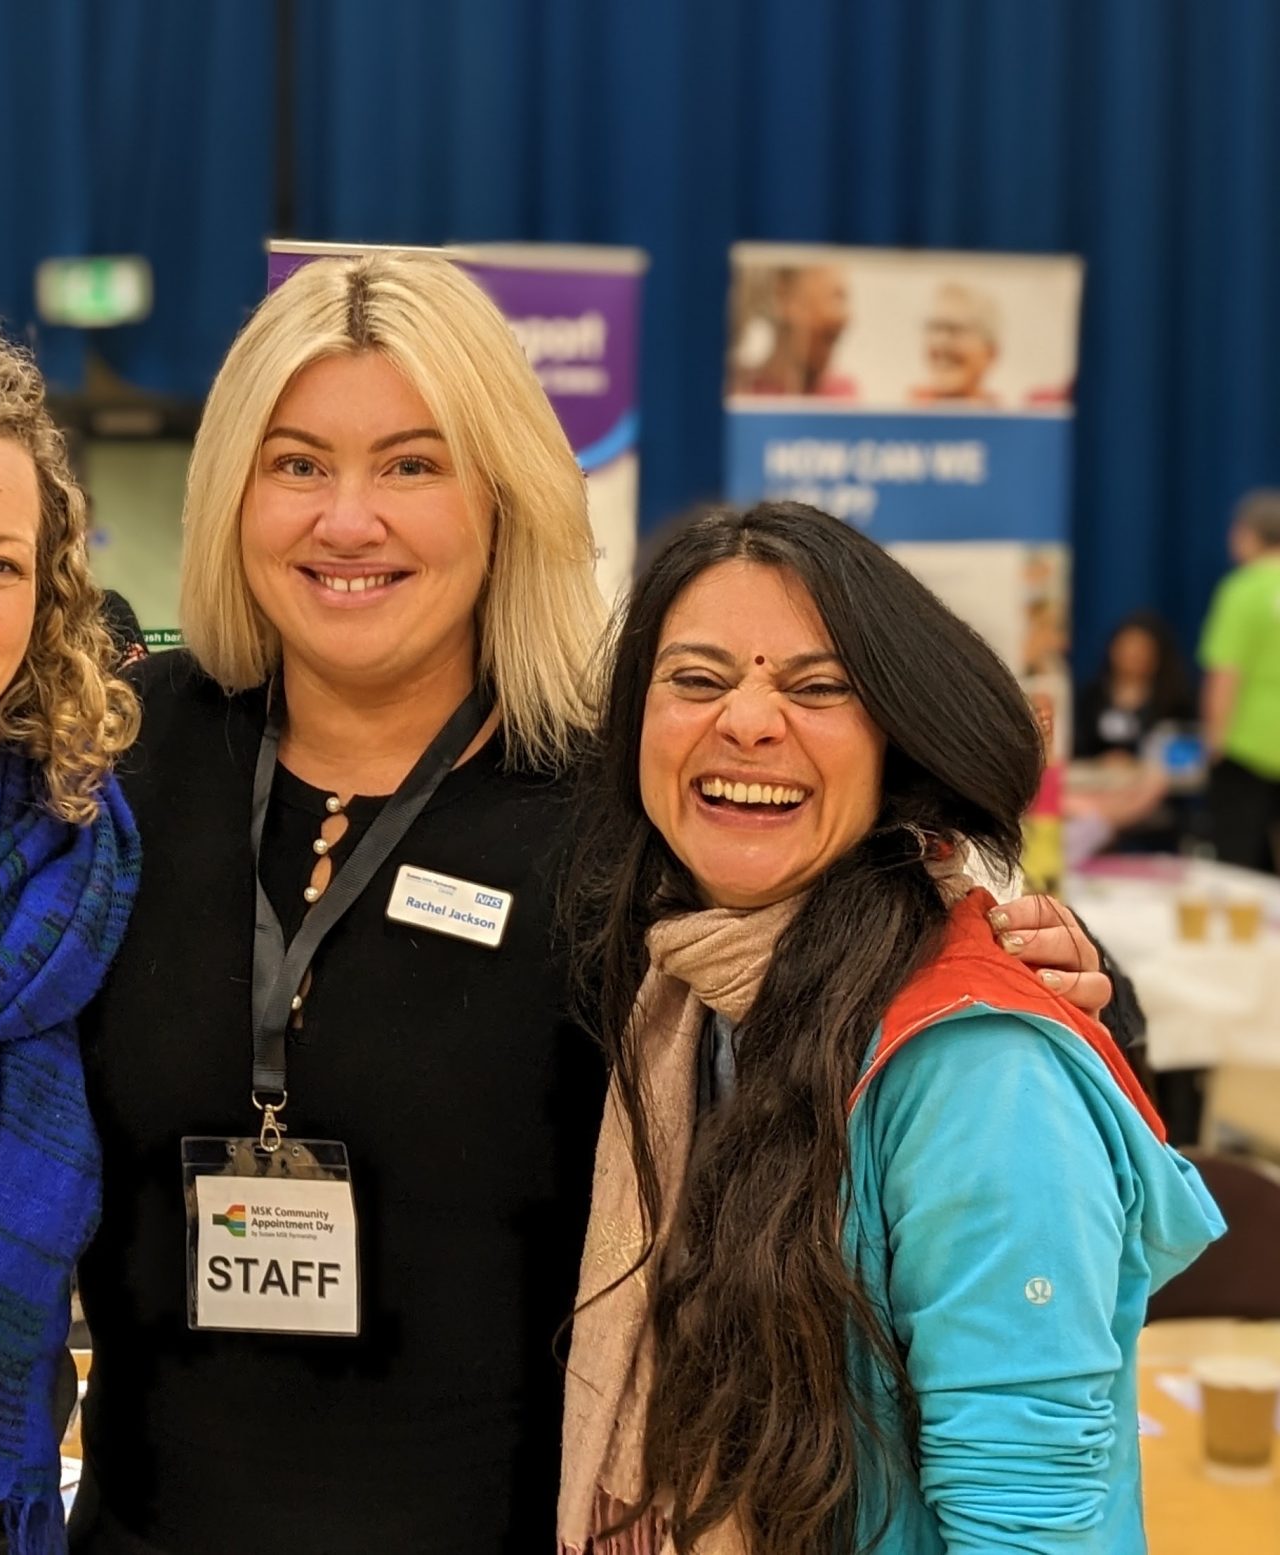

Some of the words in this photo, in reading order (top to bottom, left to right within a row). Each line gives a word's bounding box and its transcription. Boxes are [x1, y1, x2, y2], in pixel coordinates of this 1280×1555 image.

[144, 632, 162, 642] ush
[477, 893, 503, 908] NHS
[406, 896, 446, 916] Rachel
[448, 909, 496, 930] Jackson
[251, 1205, 272, 1216] MSK
[274, 1207, 329, 1220] Community
[251, 1218, 314, 1230] Appointment
[316, 1221, 334, 1233] Day
[207, 1255, 341, 1298] STAFF
